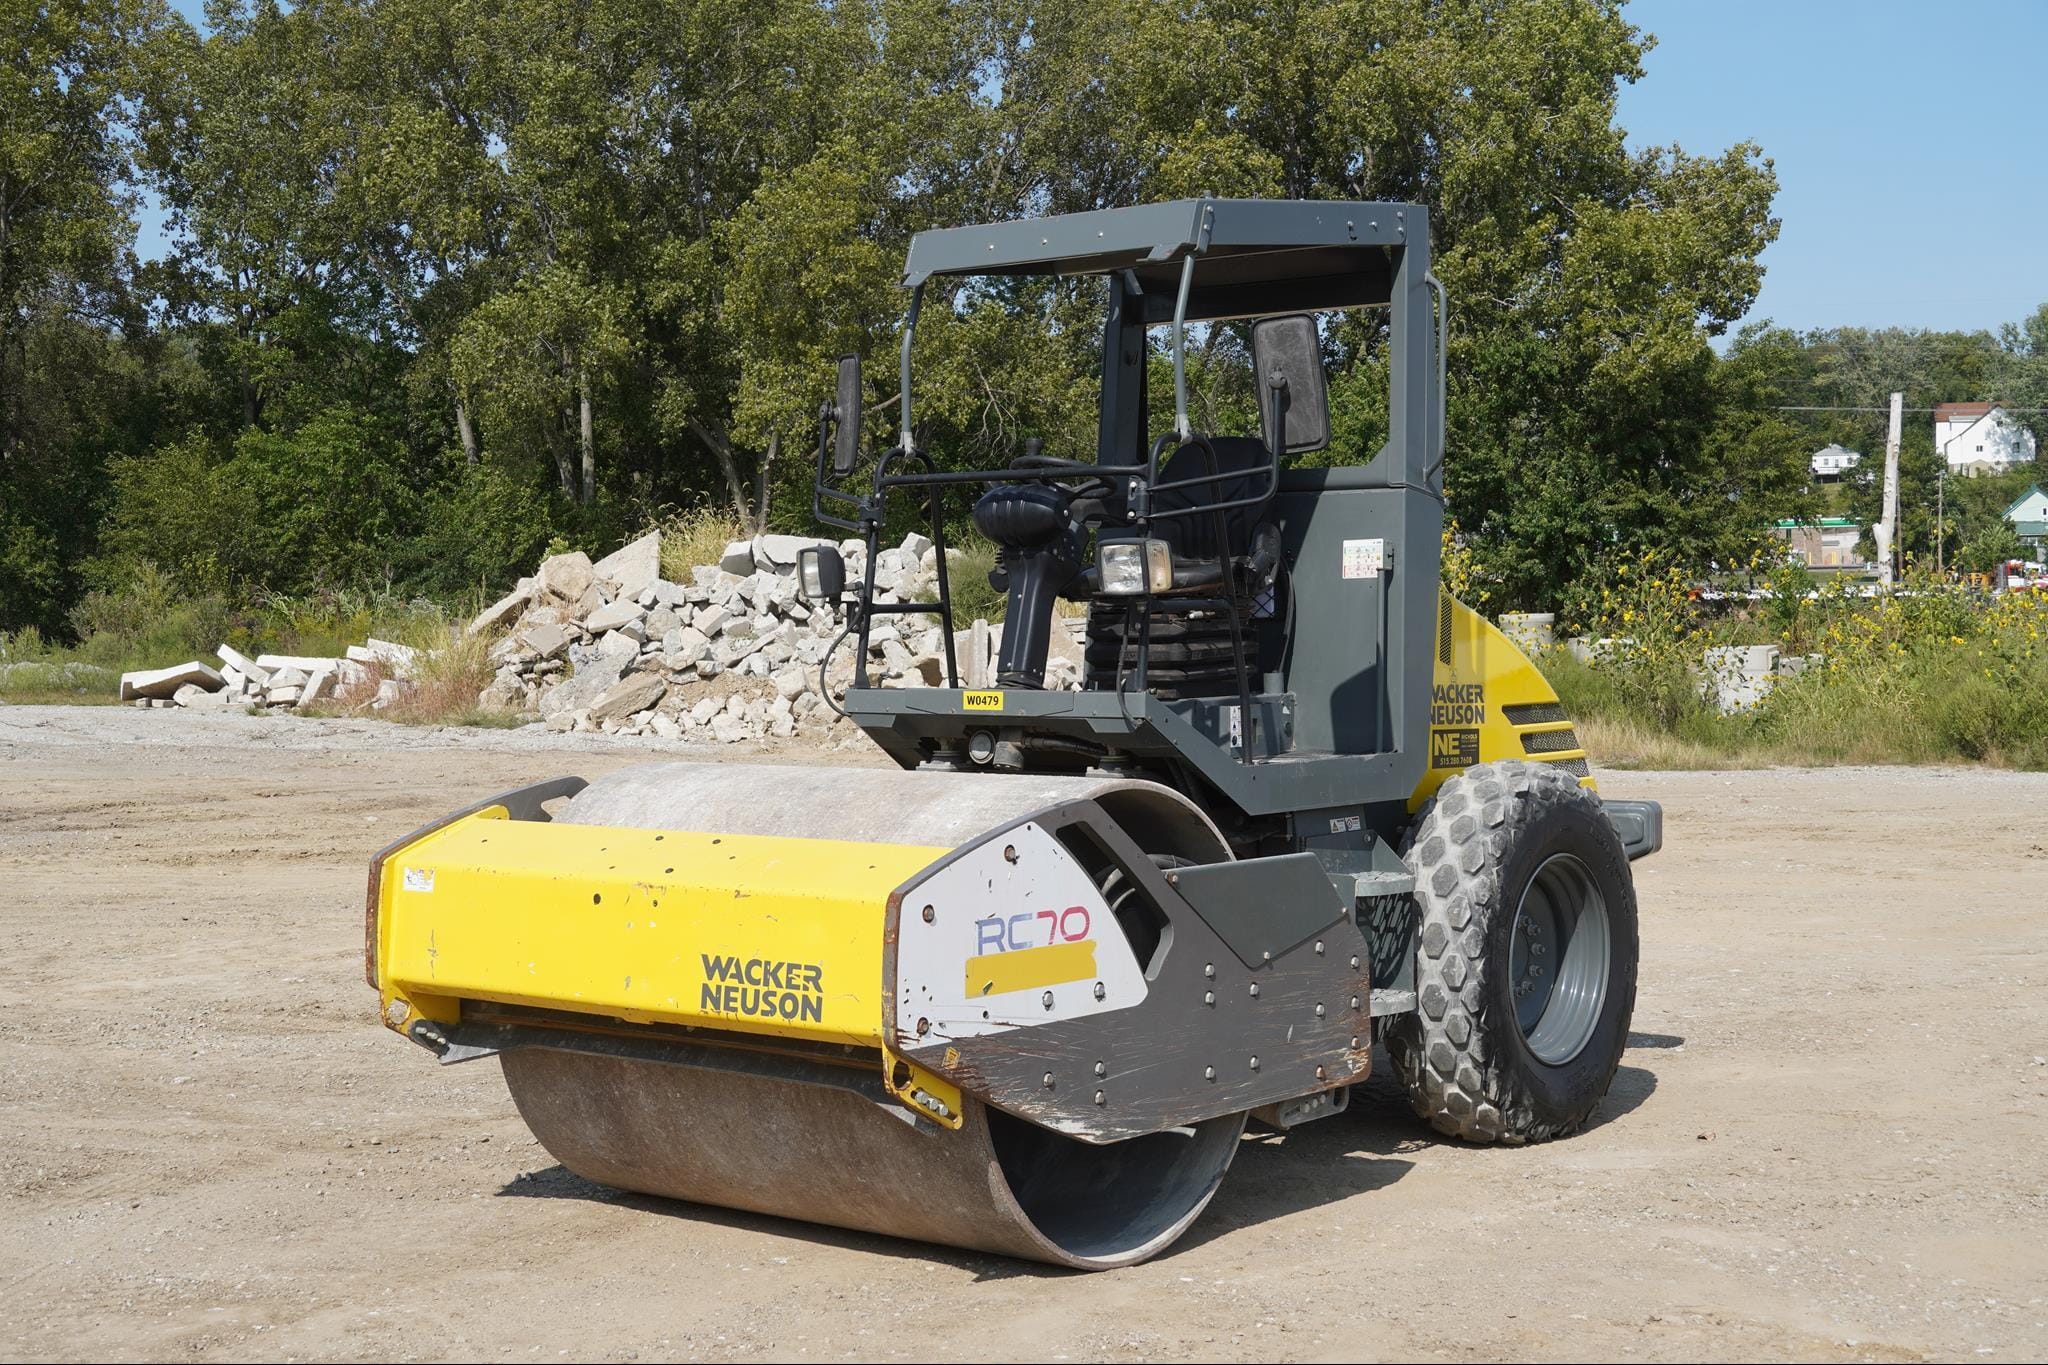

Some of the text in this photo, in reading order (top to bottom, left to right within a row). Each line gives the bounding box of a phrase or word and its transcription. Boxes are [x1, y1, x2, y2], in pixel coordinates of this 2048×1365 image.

[966, 695, 999, 706] W0479
[1434, 733, 1460, 756] NE
[976, 906, 1091, 956] RC70
[701, 953, 823, 993] WACKER
[700, 983, 823, 1023] NEUSON
